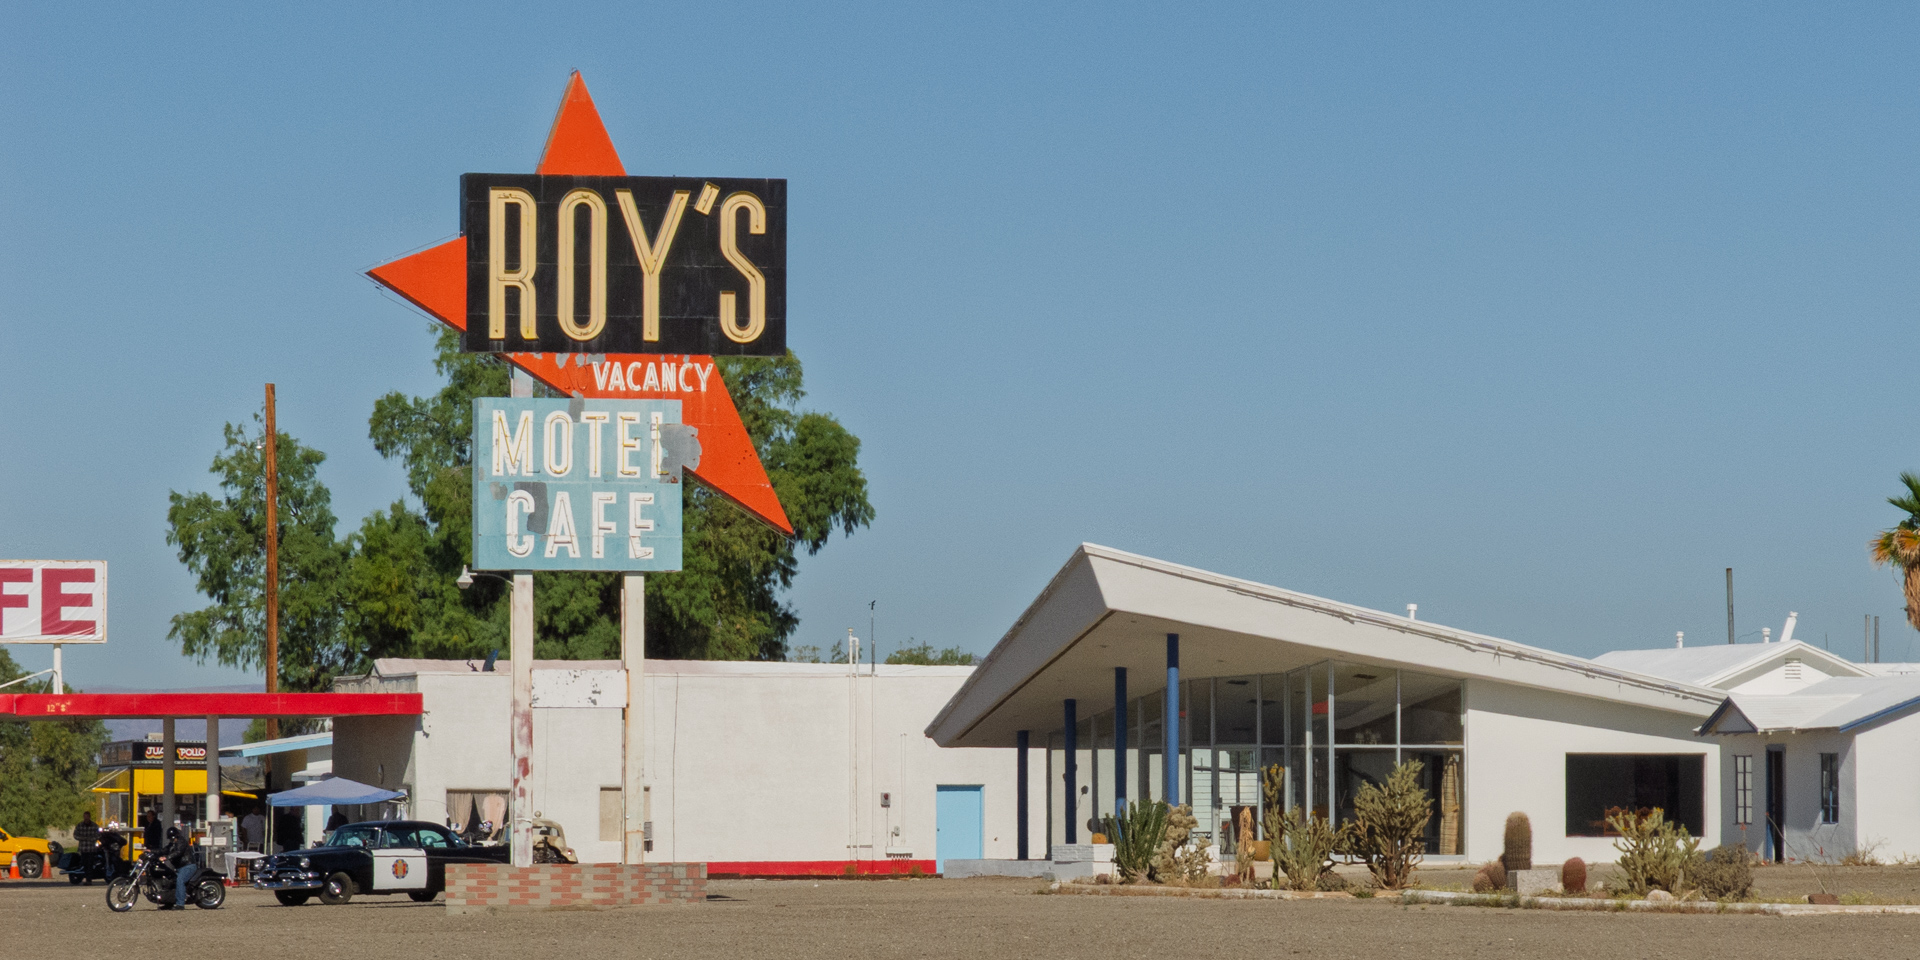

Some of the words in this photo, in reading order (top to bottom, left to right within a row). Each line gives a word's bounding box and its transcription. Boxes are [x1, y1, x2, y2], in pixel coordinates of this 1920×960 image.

[488, 181, 766, 344] ROY'S
[592, 361, 714, 393] VACANCY
[506, 489, 655, 560] CAFE
[178, 747, 206, 758] POLLO
